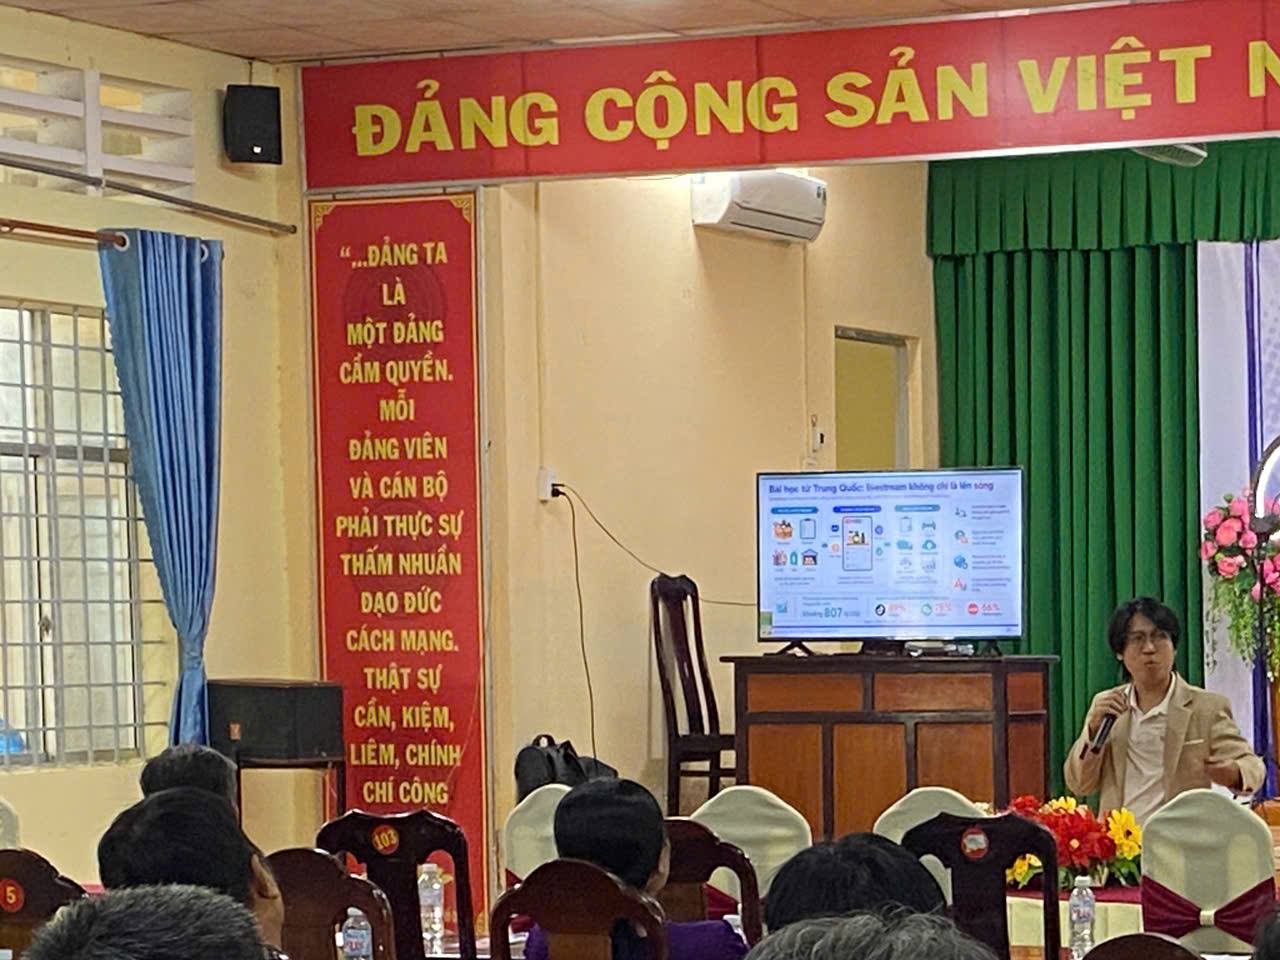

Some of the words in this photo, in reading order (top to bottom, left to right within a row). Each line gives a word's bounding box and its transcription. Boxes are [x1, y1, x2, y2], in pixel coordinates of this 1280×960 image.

[352, 78, 559, 157] ĐẢNG
[585, 69, 799, 151] CỘNG
[824, 46, 990, 130] SẢN
[1018, 36, 1212, 121] VIỆT
[423, 241, 448, 264] TA
[382, 277, 406, 306] LÀ
[347, 317, 387, 349] MỘT
[393, 313, 444, 343] ĐẢNG
[339, 352, 380, 384] CẦM
[380, 389, 415, 421] MỖI
[349, 430, 399, 461] ĐẢNG
[403, 432, 448, 459] VIÊN
[349, 472, 373, 499] VÀ
[380, 471, 417, 499] CÁN
[423, 470, 448, 502] BỘ
[335, 507, 378, 538] PHẢI
[384, 511, 433, 541] THỰC
[438, 510, 464, 539] SỰ
[340, 545, 393, 576] THẤM
[399, 544, 462, 576] NHUẦN
[361, 591, 399, 618] ĐẠO
[404, 586, 442, 614] ĐỨC
[346, 624, 395, 652] CÁCH
[363, 662, 412, 694] THẬT
[417, 663, 443, 692] SỰ
[354, 697, 396, 732] CẦN,
[402, 702, 454, 732] KIỆM,
[350, 739, 400, 770] LIÊM,
[405, 736, 461, 767] CHÍNH
[363, 776, 393, 804] CHÍ
[399, 777, 448, 804] CÔNG
[373, 828, 397, 850] 103
[6, 886, 17, 904] 5
